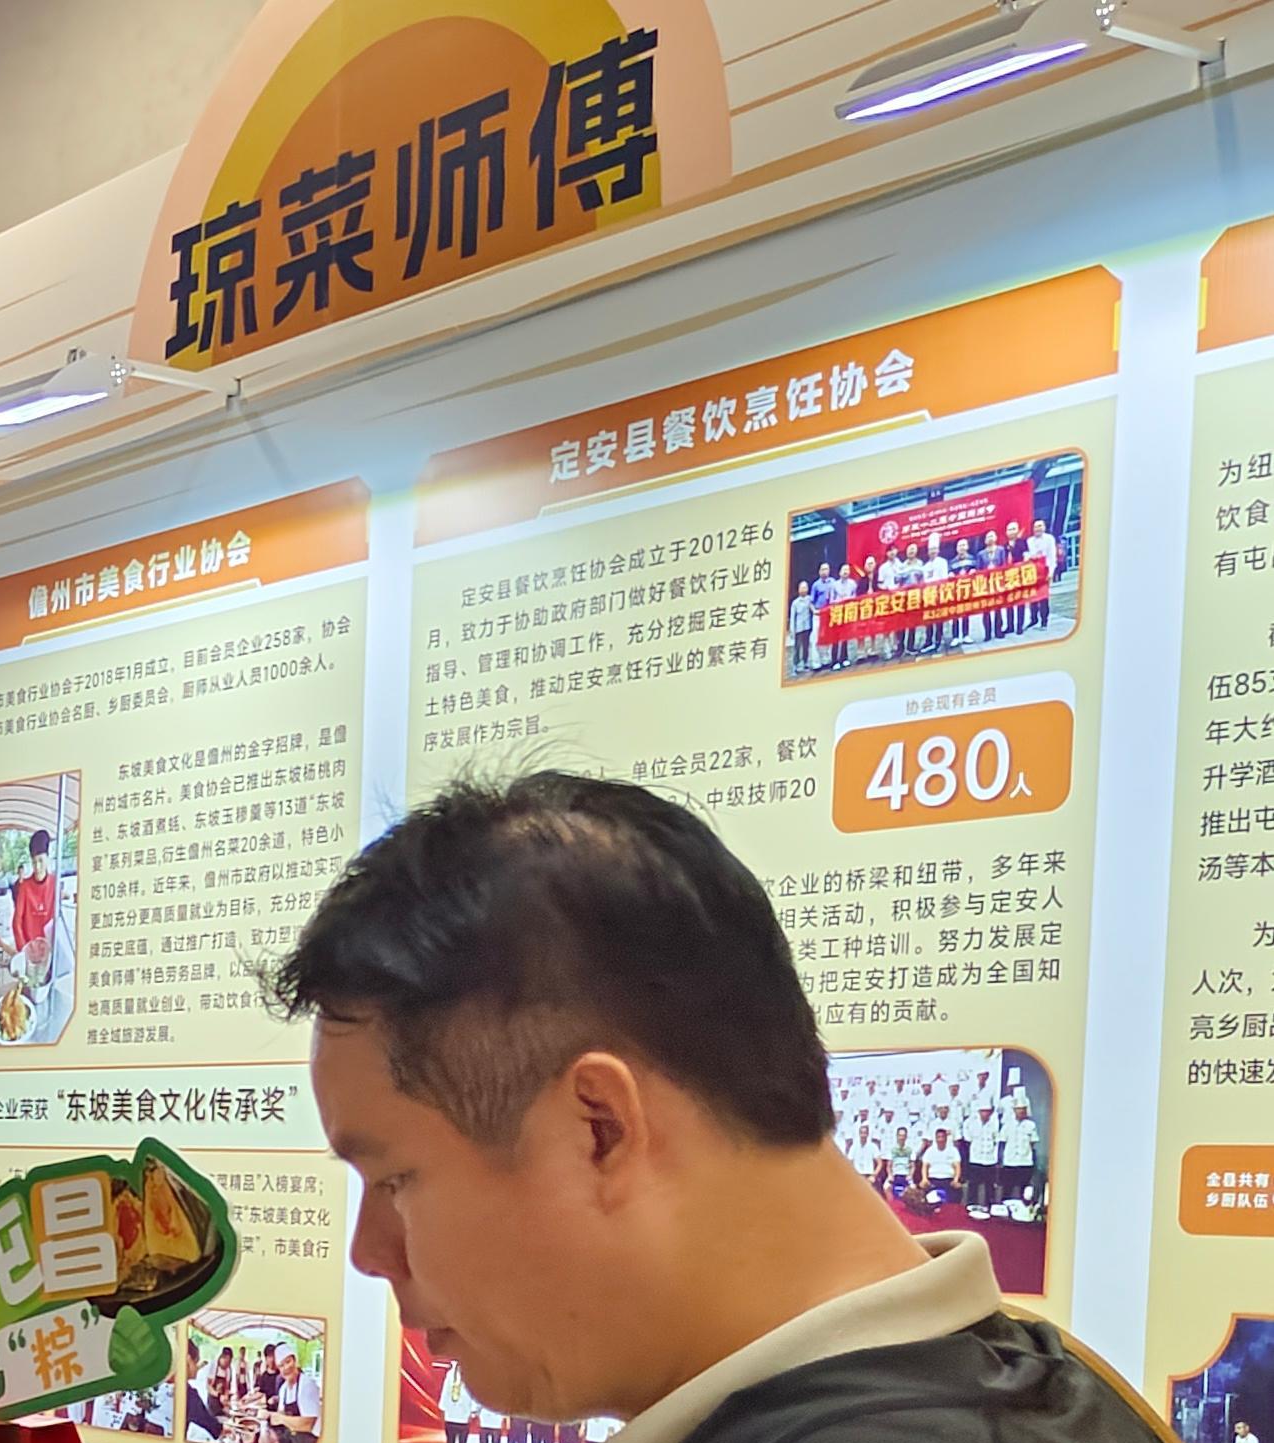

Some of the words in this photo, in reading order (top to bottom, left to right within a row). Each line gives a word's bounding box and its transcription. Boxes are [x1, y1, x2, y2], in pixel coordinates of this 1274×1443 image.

[165, 26, 658, 361] 琼菜师傅
[549, 349, 916, 484] 定安县餐饮烹饪协会
[1215, 498, 1270, 532] 饮食
[28, 529, 252, 620] 儋州市美食行业协会
[461, 520, 774, 609] 定安县餐饮烹饪协会成立于2012年6
[1213, 545, 1274, 578] 有屯
[425, 599, 770, 683] 指导、管理和协调工作，充分挖掘定安本
[426, 559, 772, 649] 月，致力于协助政府部门做好餐饮行业的
[424, 638, 769, 717] 土特色美食，推动定安烹饪行业的繁荣有
[905, 687, 997, 716] 协会现有会员
[1208, 669, 1274, 701] 伍85
[423, 714, 552, 752] 序发展作为宗旨。
[1190, 1013, 1274, 1041] 亮乡厨
